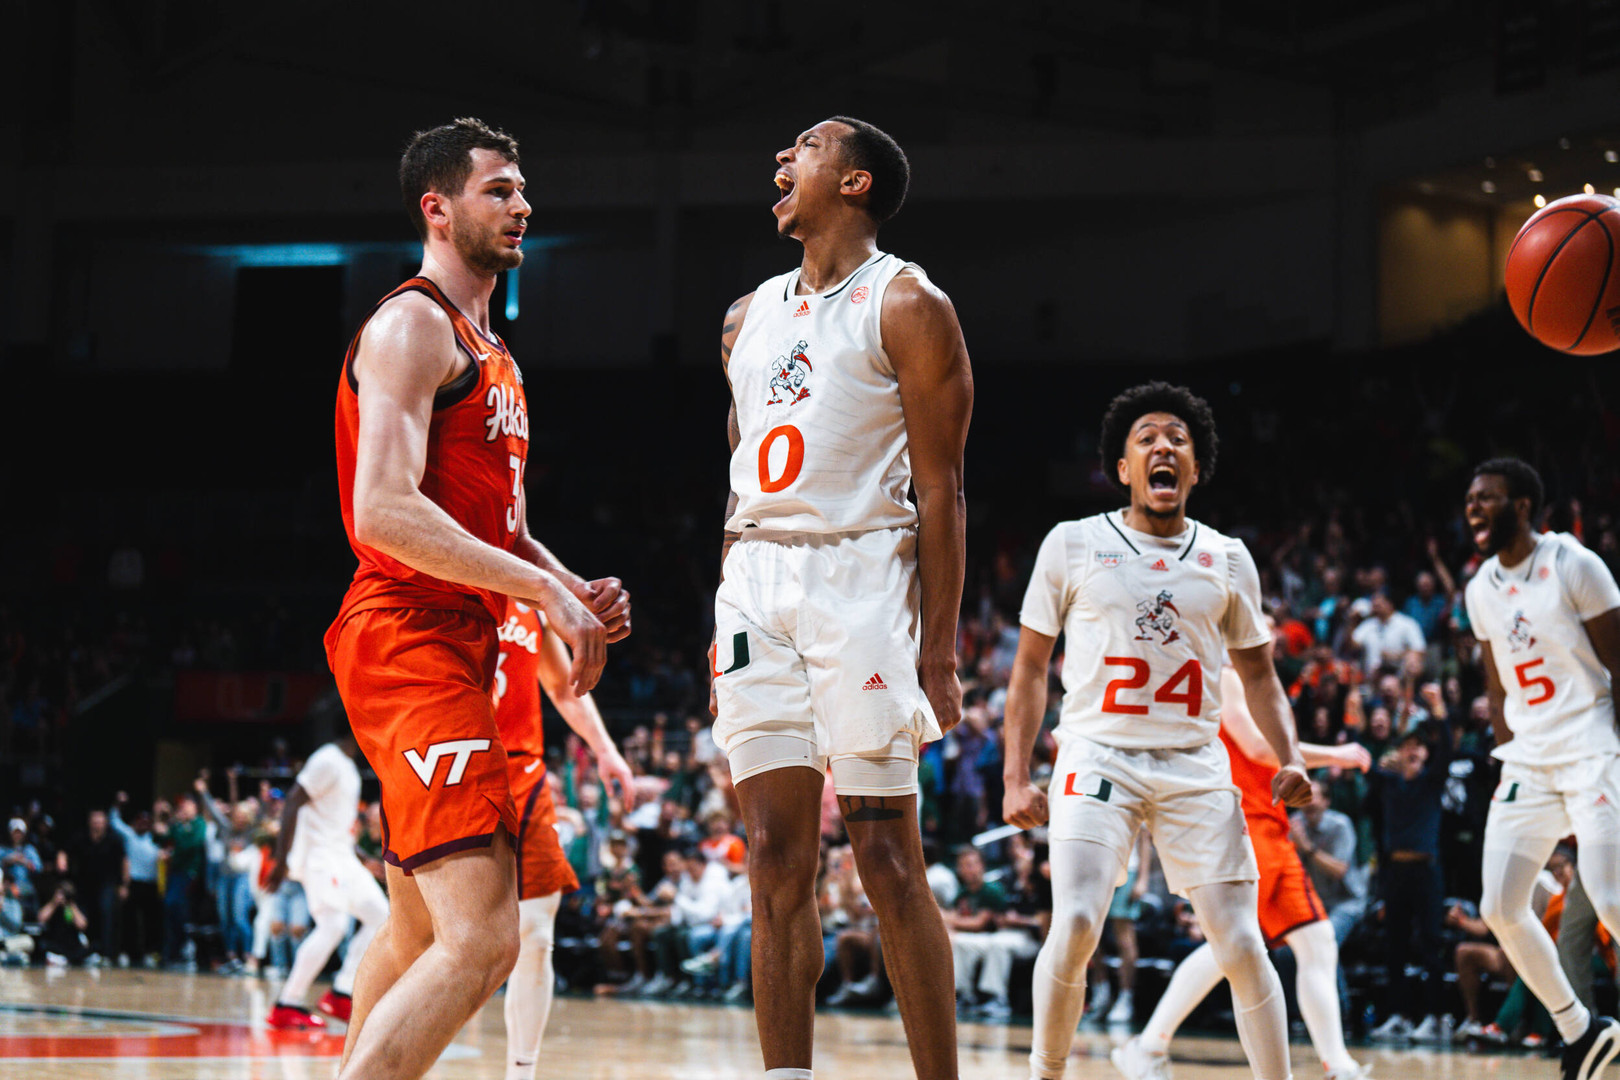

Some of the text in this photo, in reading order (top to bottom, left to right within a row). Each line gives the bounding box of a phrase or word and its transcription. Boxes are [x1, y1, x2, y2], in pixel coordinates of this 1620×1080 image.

[758, 424, 805, 493] 0
[862, 683, 887, 691] adidas
[1101, 656, 1203, 717] 24
[1514, 657, 1556, 706] 5
[401, 738, 493, 791] VT
[1064, 772, 1113, 803] U
